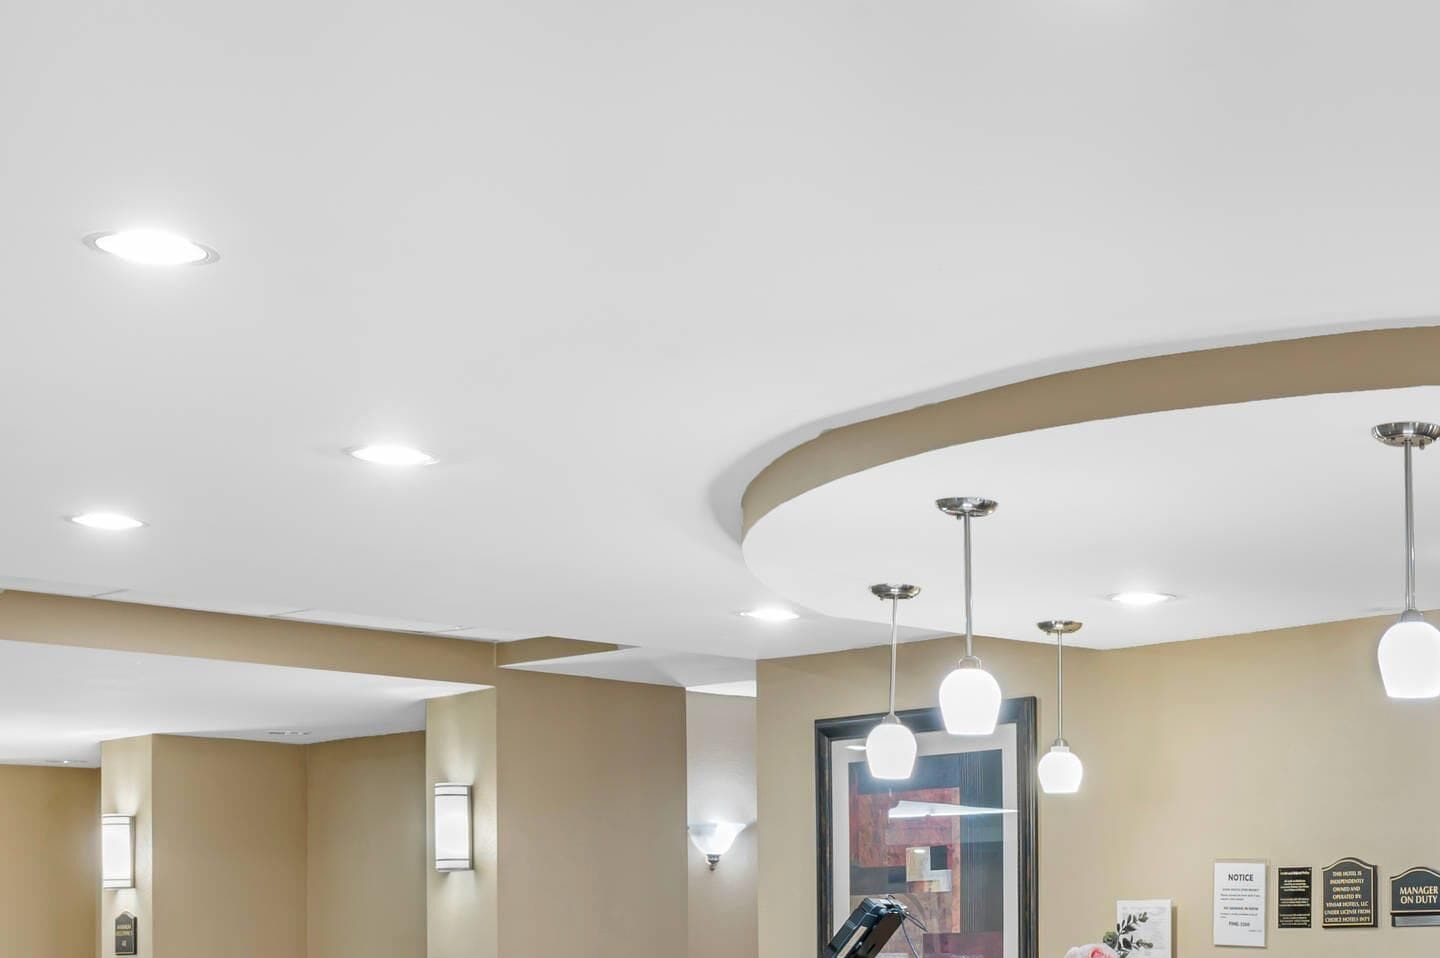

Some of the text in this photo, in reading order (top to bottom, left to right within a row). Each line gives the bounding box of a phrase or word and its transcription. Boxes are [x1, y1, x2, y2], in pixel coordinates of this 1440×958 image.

[1400, 886, 1439, 895] MANAGER
[1400, 895, 1438, 904] ON DUTY
